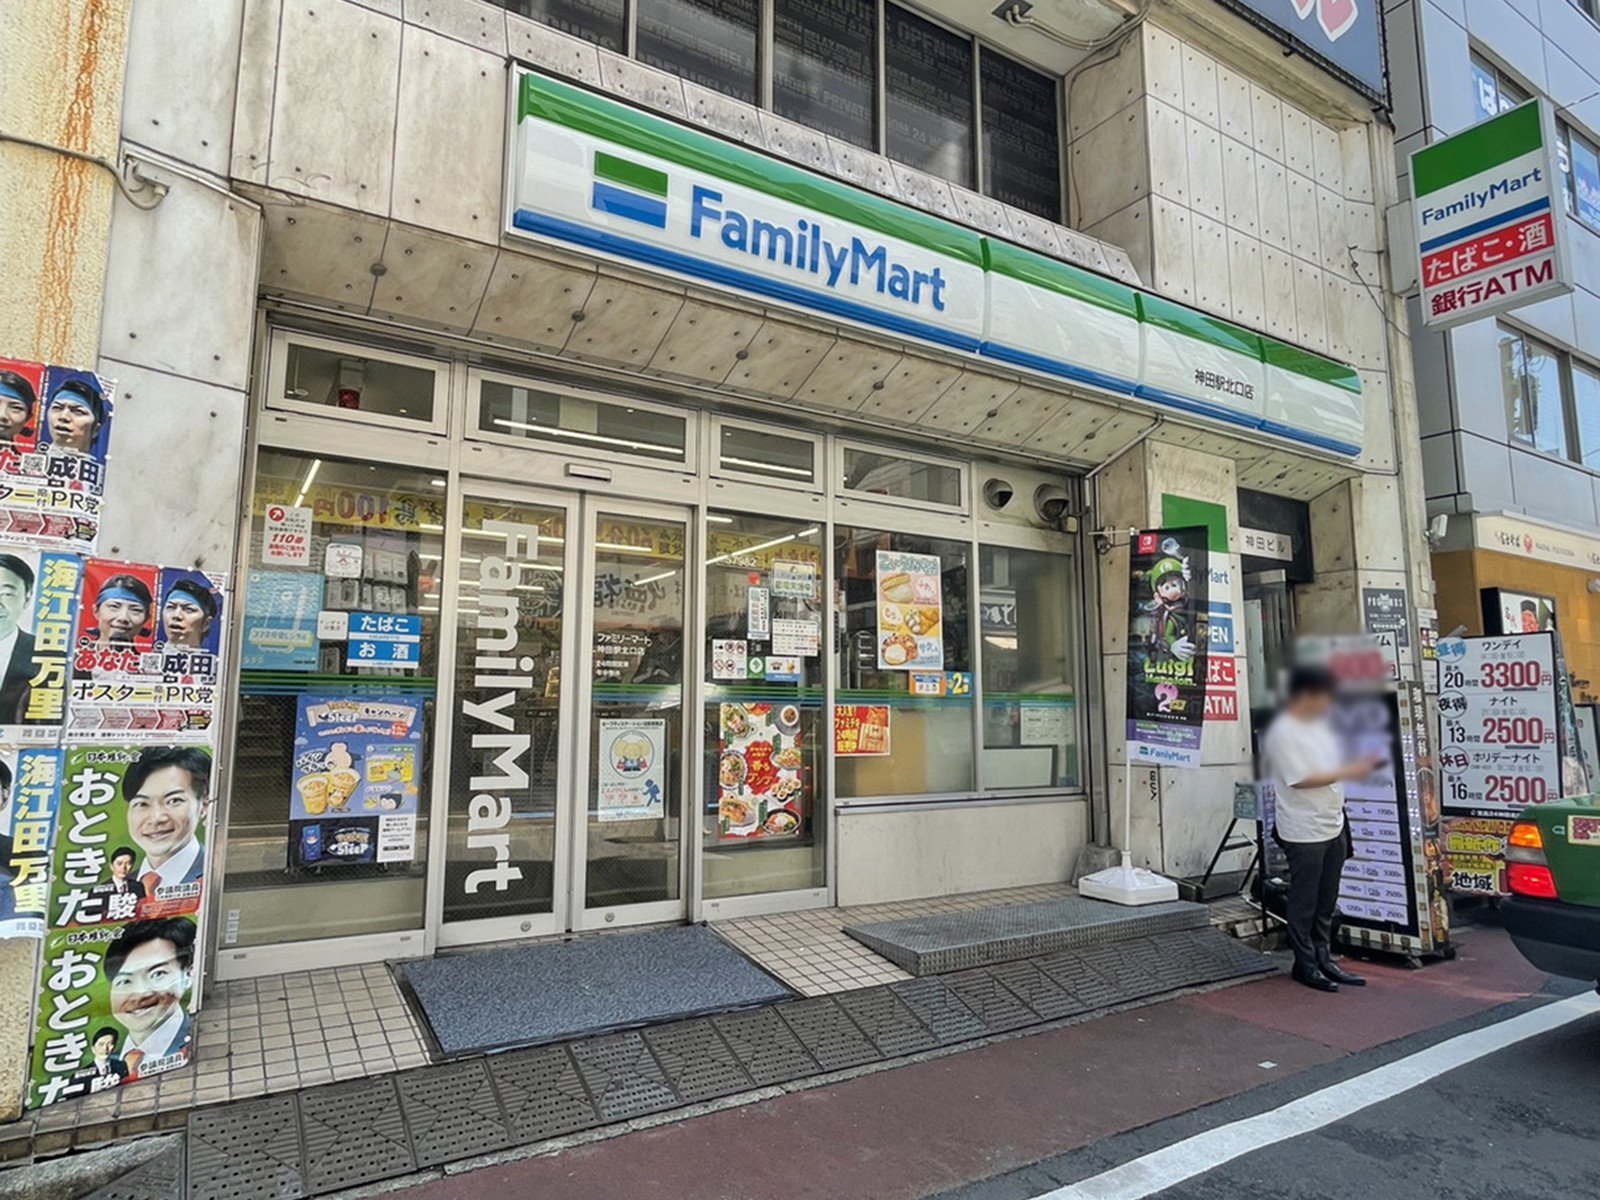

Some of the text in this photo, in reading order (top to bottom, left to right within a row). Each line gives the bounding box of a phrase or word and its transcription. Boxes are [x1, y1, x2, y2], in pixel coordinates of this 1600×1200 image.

[1422, 166, 1542, 226] FamilyMart
[690, 184, 946, 312] FamilyMart
[1427, 219, 1547, 282] たばこ・酒
[1431, 259, 1553, 316] 銀行ATM
[1195, 368, 1255, 400] 神田駅北口店
[47, 456, 100, 485] 成田
[360, 615, 410, 633] たばこ
[25, 558, 78, 720] 海江田万里
[596, 645, 645, 656] 神田駅北口店
[597, 632, 653, 647] ファミリーマート
[1482, 640, 1521, 651] ワンデイ
[76, 648, 139, 673] あなた
[163, 653, 213, 675] 成田
[1144, 656, 1194, 677] Luigi
[1206, 660, 1233, 682] ばこ
[1480, 660, 1552, 689] 3300円
[462, 518, 539, 894] FamilyMart
[1155, 683, 1178, 713] 2
[1203, 695, 1235, 714] ATM
[1490, 696, 1517, 706] ナイト
[364, 707, 404, 718] キャンペーン
[1482, 717, 1555, 744] 2500円
[1150, 748, 1191, 763] FamilyMart
[1439, 753, 1469, 768] 休日
[1473, 752, 1540, 763] ホリデーナイト
[9, 754, 58, 914] 海江田万里
[55, 767, 120, 927] おときた
[1452, 871, 1493, 892] 地域
[107, 893, 138, 920] 駿
